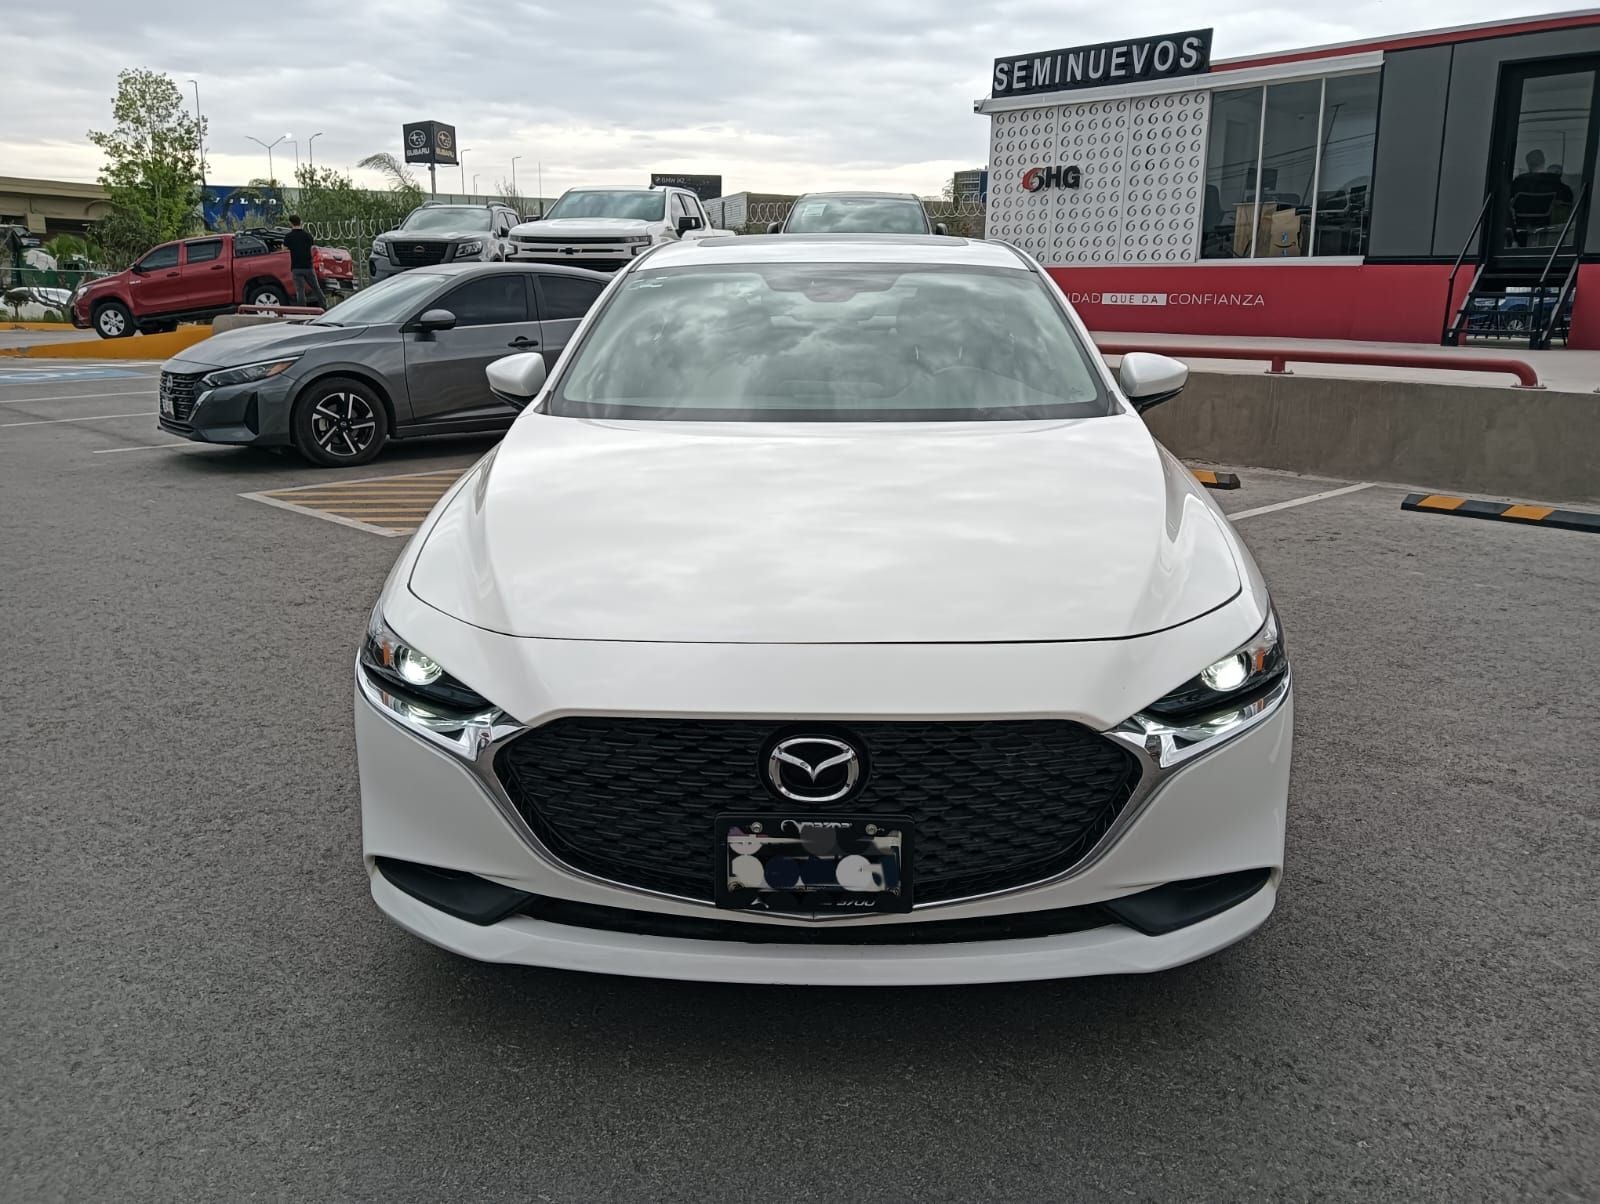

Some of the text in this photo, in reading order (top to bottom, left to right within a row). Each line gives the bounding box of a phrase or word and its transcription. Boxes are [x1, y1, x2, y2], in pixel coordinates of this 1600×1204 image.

[993, 37, 1201, 91] SEMINUEVOS
[407, 147, 430, 157] SUBARU
[1111, 294, 1135, 304] QUE
[1141, 294, 1158, 304] DA
[1168, 293, 1265, 306] CONFIANZA
